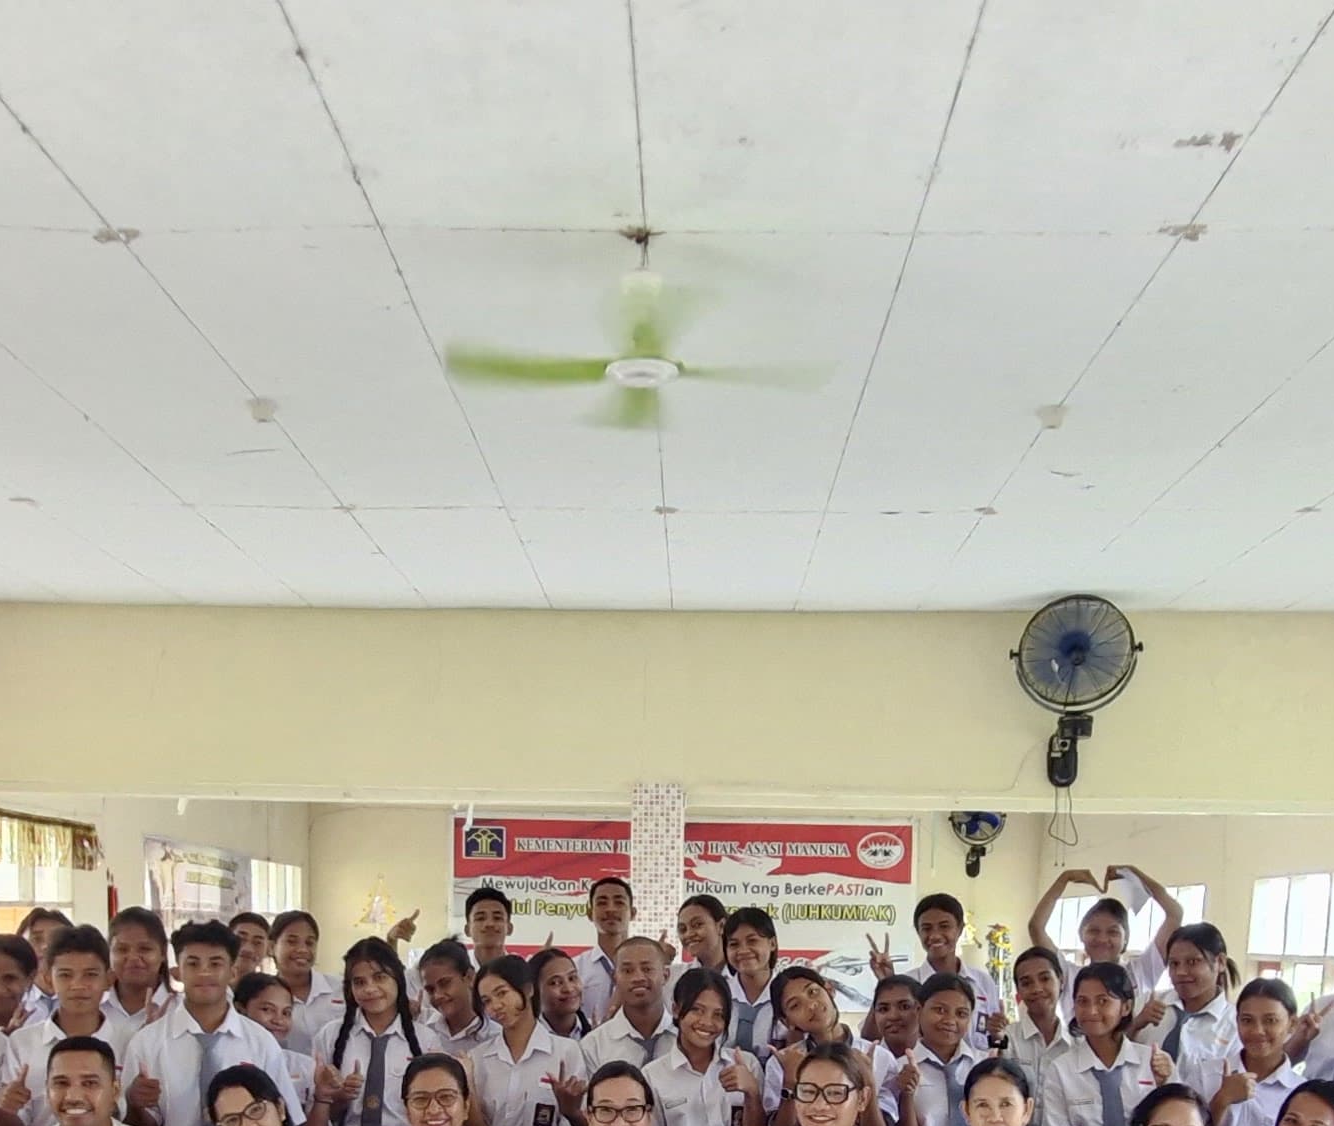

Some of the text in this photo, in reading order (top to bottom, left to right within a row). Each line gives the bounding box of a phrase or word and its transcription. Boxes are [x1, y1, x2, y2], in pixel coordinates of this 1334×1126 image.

[516, 839, 613, 852] KEMENTERIAN
[684, 842, 850, 857] AN HAK ASASI MANUSIA
[482, 878, 576, 892] Mewujudkan
[686, 881, 884, 897] Hukum Yang BerkePASTIan
[535, 899, 588, 919] Penyu
[782, 902, 896, 924] (LUHKUMTAK)
